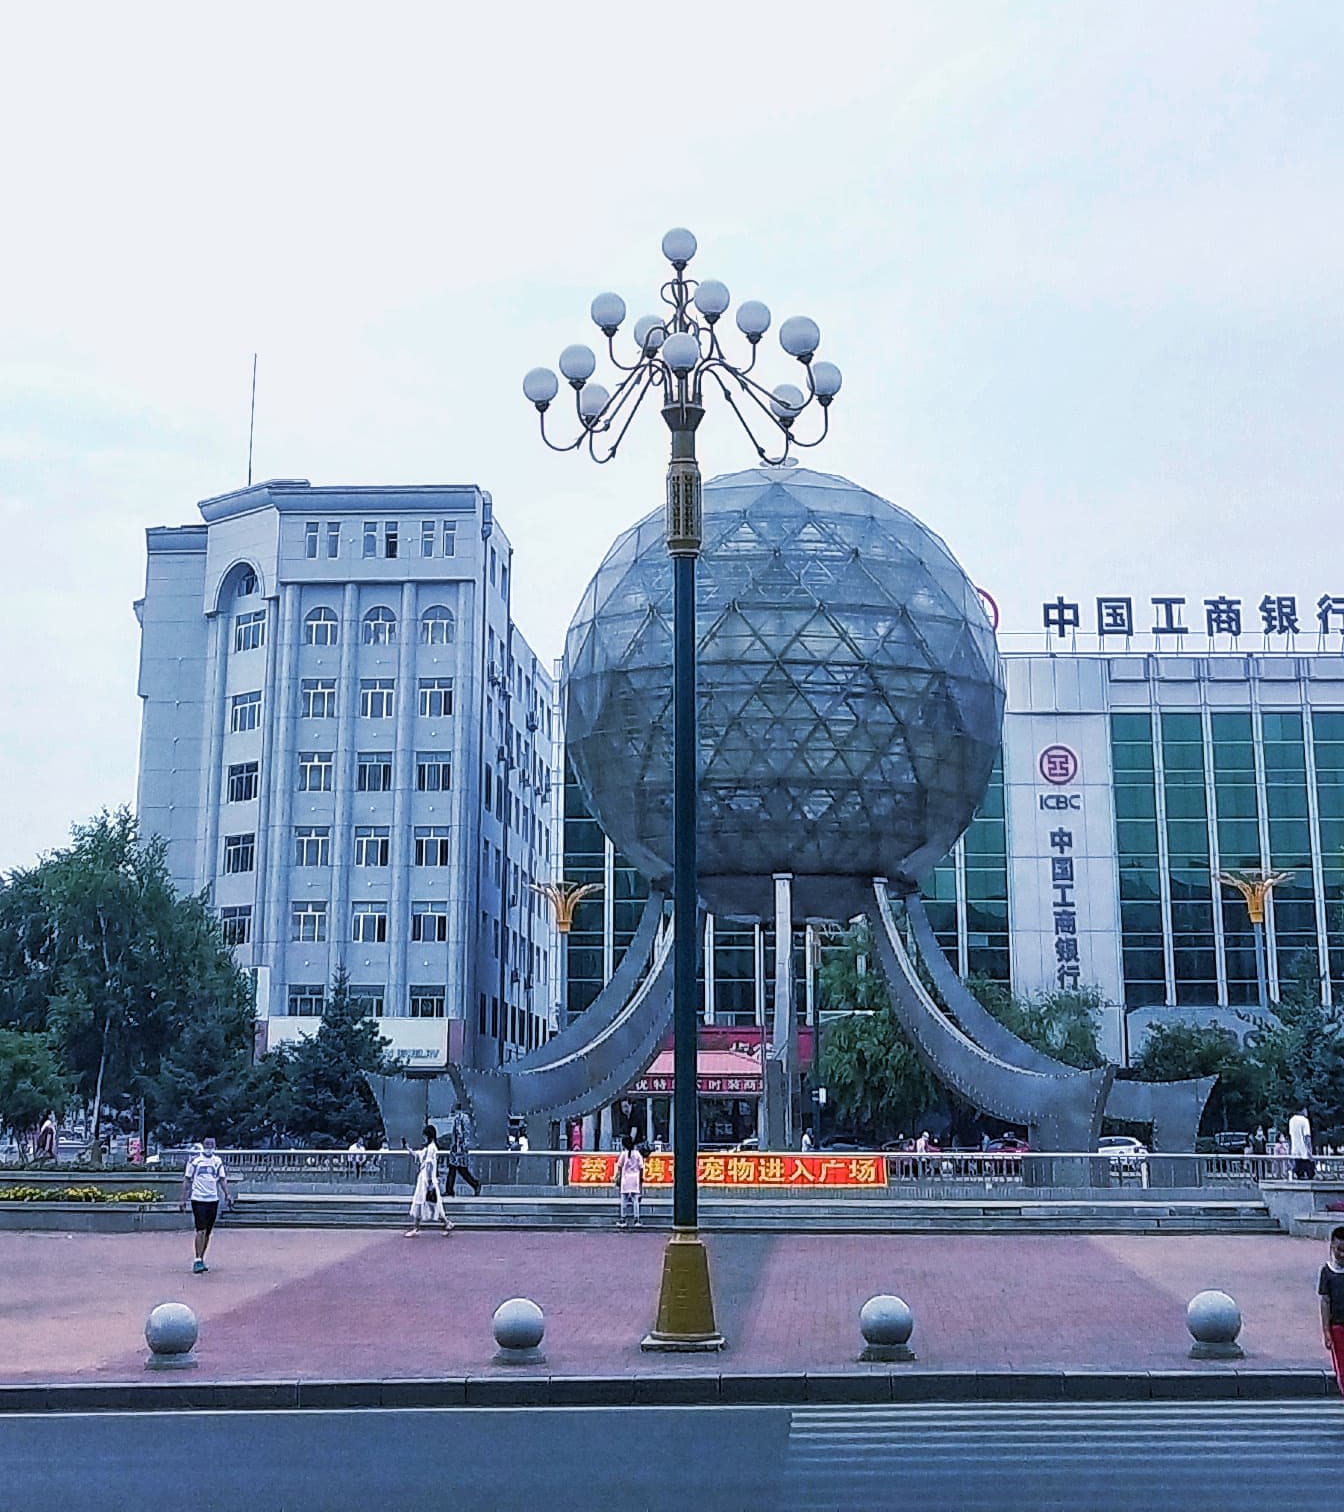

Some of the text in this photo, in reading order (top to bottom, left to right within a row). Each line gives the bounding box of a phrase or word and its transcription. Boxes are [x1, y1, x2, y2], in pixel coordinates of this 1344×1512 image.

[1039, 794, 1081, 810] ICBC
[1049, 826, 1082, 990] 中国工商银行
[580, 1156, 877, 1183] 禁携宠物进入广场
